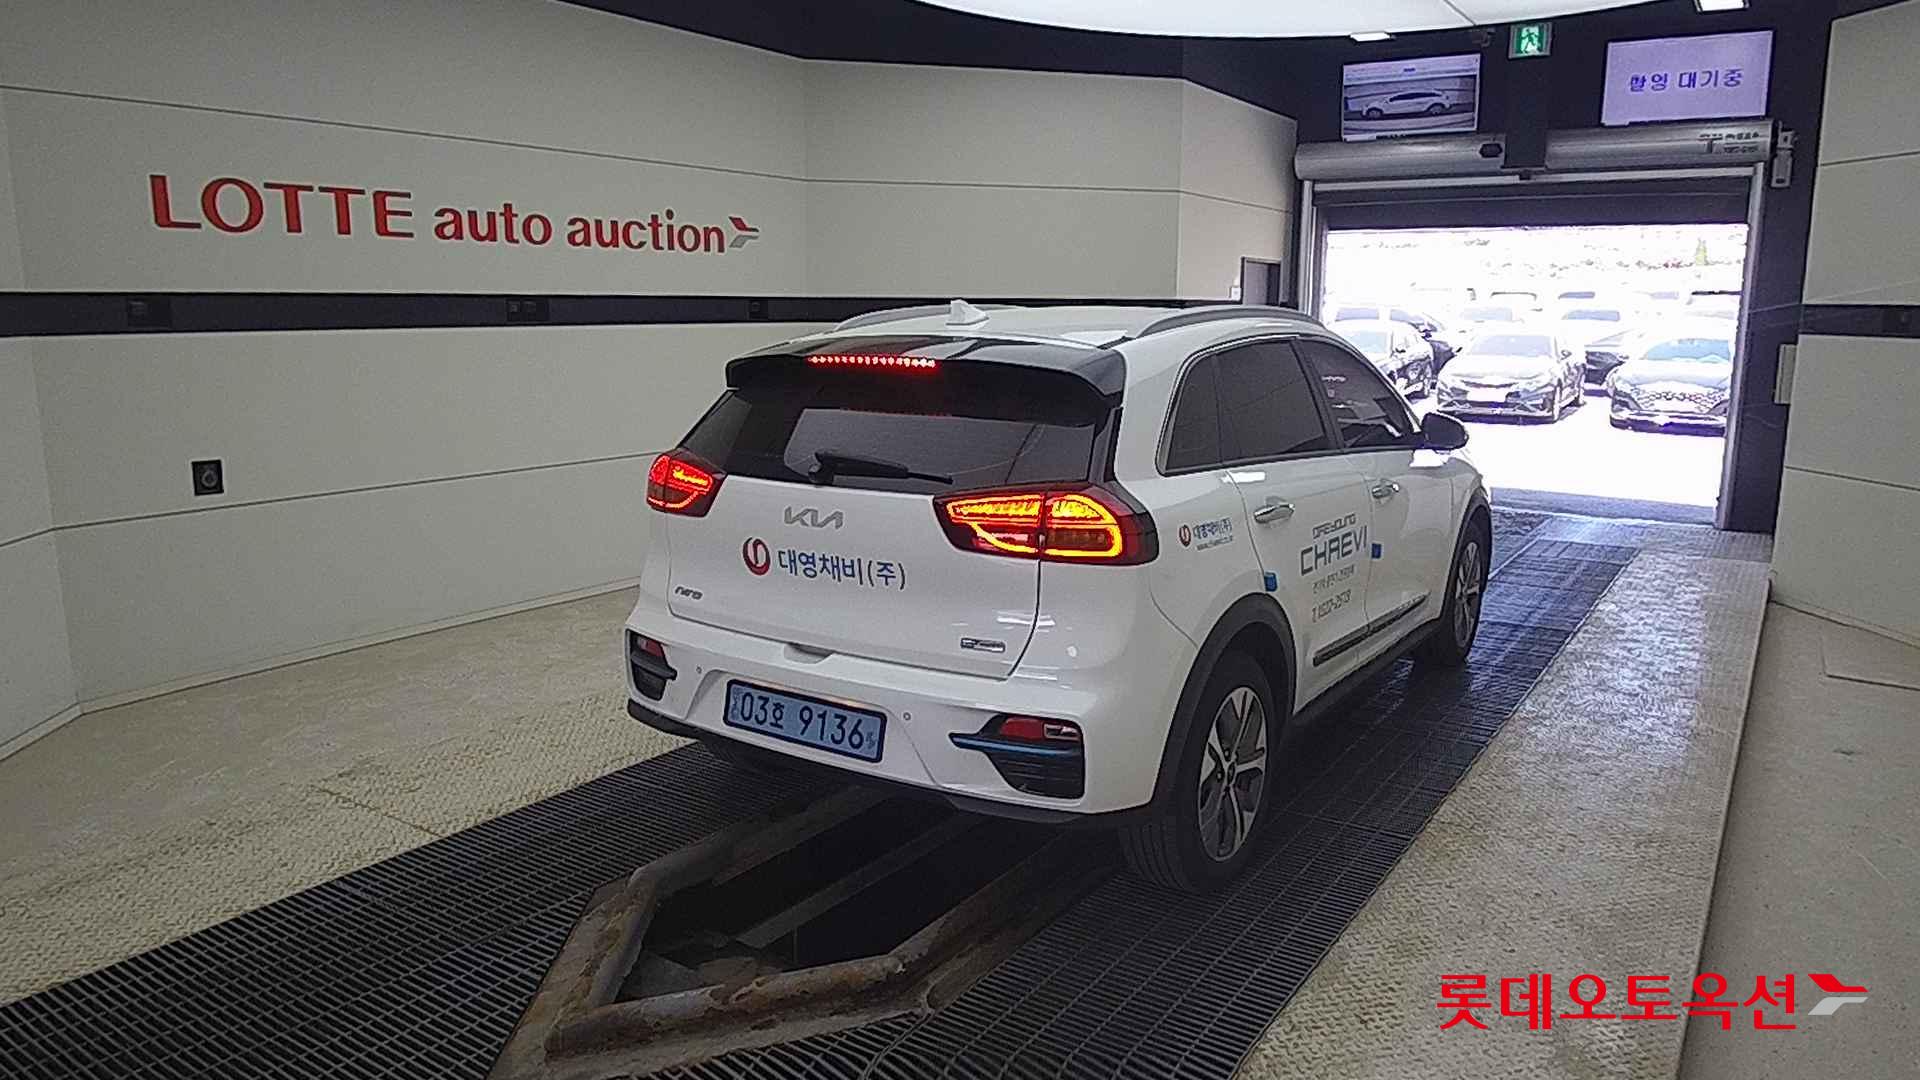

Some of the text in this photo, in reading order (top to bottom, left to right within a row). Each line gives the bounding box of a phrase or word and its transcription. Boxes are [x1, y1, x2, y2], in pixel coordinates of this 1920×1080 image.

[1678, 68, 1743, 88] 대기중
[149, 174, 726, 253] LOTTE auto auction
[778, 549, 906, 590] 대영채비(주)
[1301, 525, 1368, 576] CHAEVI
[740, 692, 864, 749] 03호 9136
